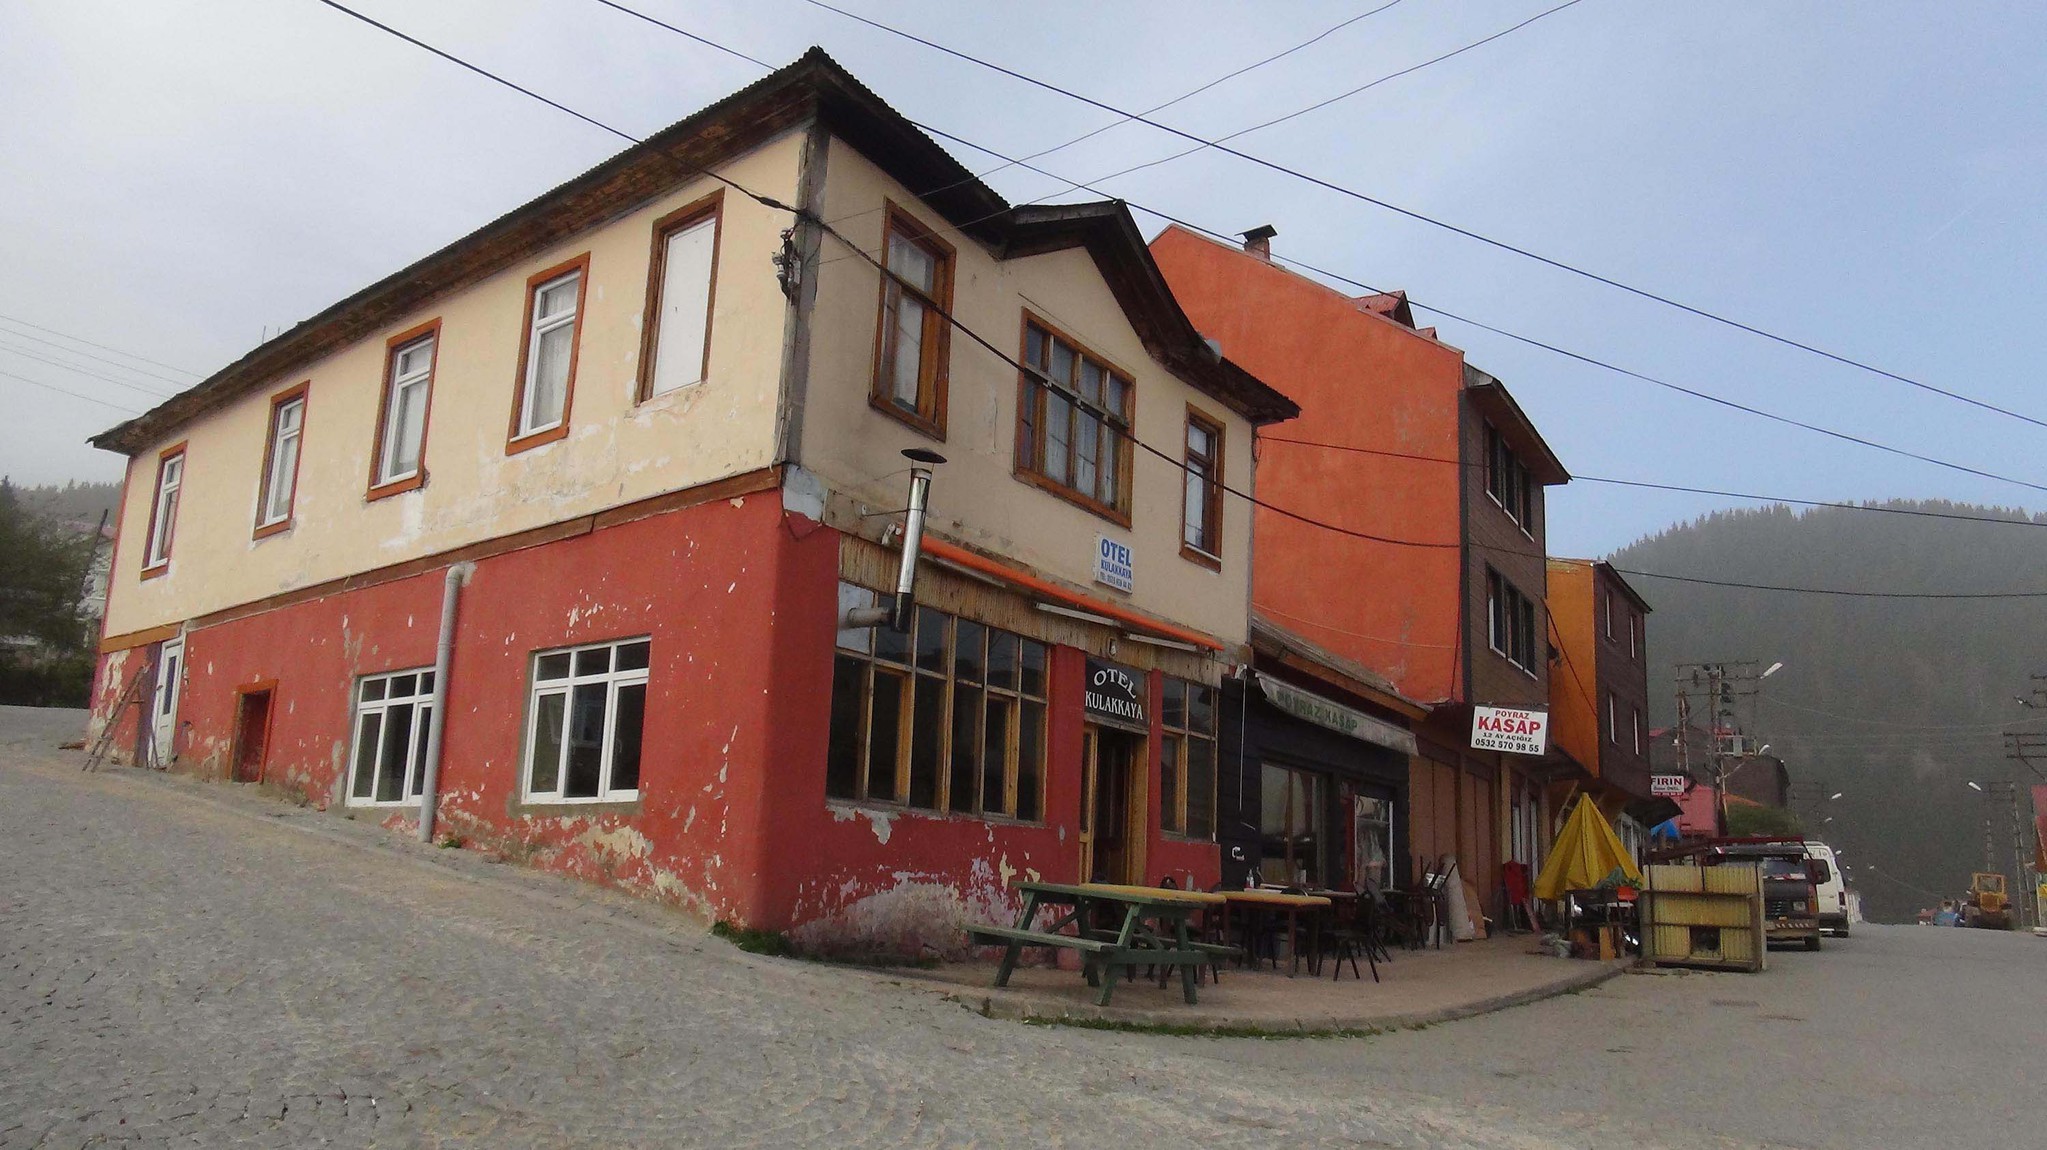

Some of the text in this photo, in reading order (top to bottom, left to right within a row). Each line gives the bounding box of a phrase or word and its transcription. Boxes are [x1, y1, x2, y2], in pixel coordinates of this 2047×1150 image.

[1101, 538, 1132, 568] OTEL
[1101, 559, 1132, 581] KULAKKAYA
[1093, 668, 1137, 699] OTEL
[1085, 691, 1143, 720] KULAKKAYA
[1495, 710, 1529, 720] POYRAZ
[1478, 716, 1541, 735] KASAP
[1475, 738, 1539, 753] 0532 570 98 55
[1651, 777, 1682, 786] FIRIN
